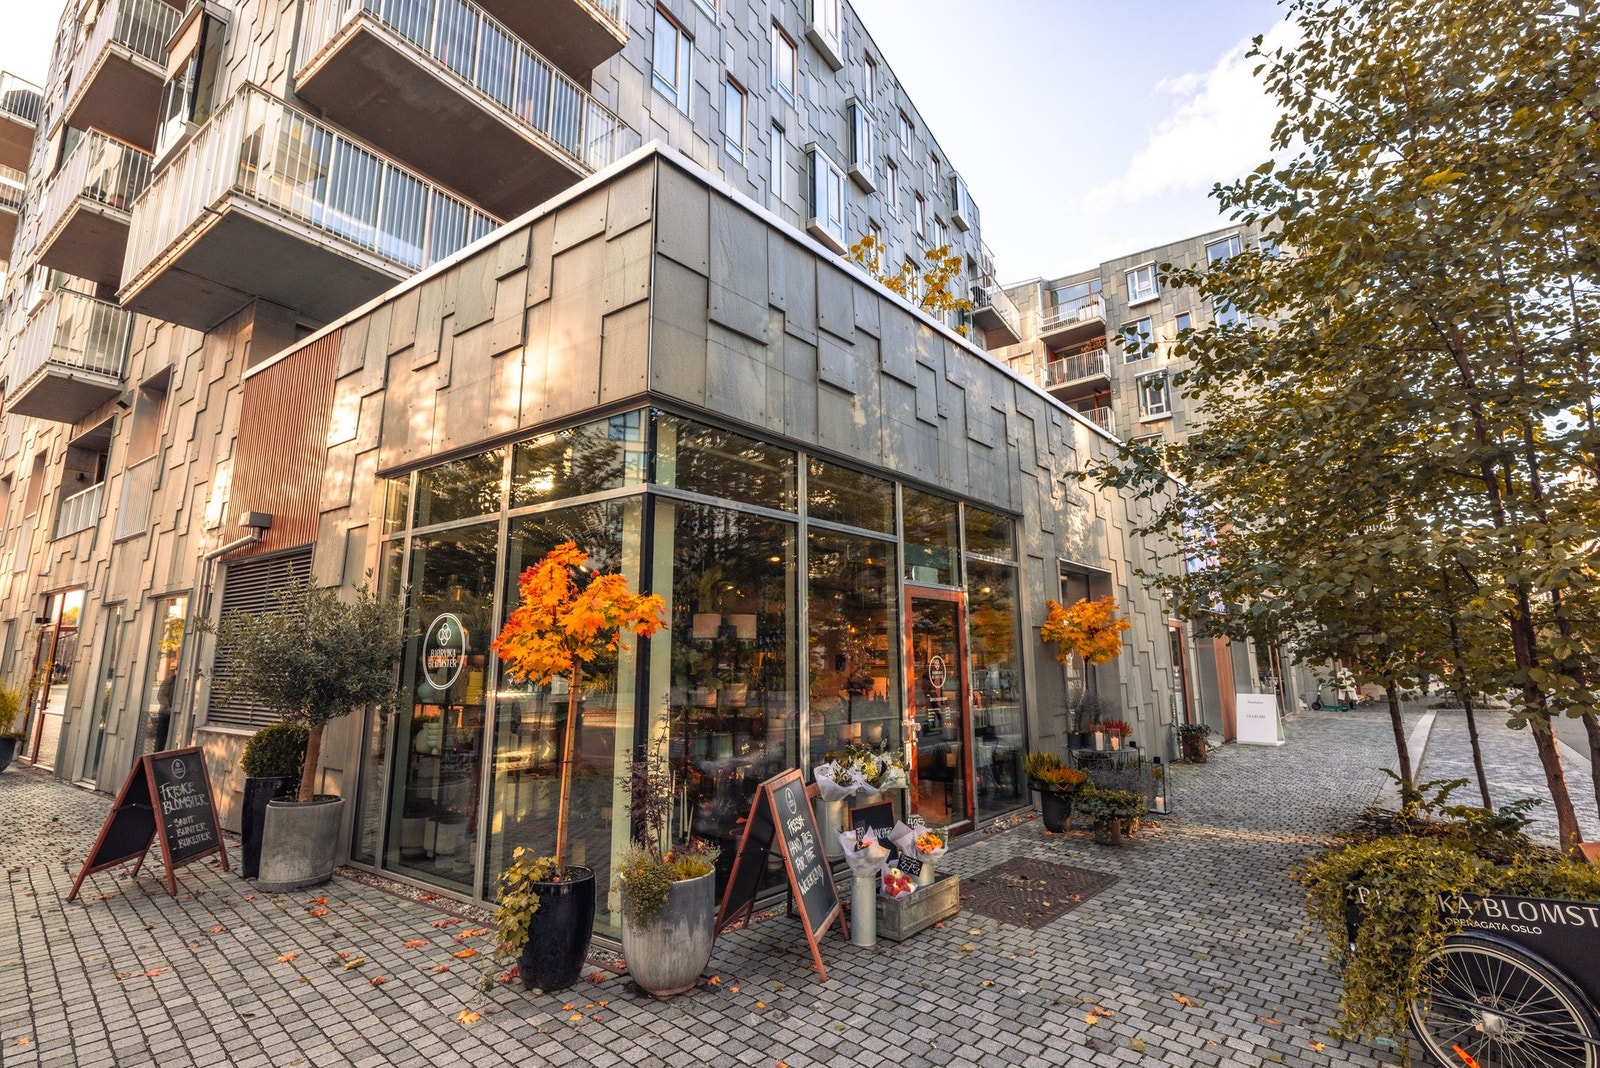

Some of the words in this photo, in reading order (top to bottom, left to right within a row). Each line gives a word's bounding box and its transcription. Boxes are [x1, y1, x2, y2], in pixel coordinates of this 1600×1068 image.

[160, 782, 196, 800] FRISKE
[162, 793, 209, 815] BLOMSTER
[787, 815, 805, 836] FRESH
[795, 856, 807, 874] FOR
[804, 846, 816, 863] THE
[798, 864, 825, 896] WEEKEND
[1482, 898, 1599, 928] BLOMST
[1510, 924, 1543, 935] OSLO
